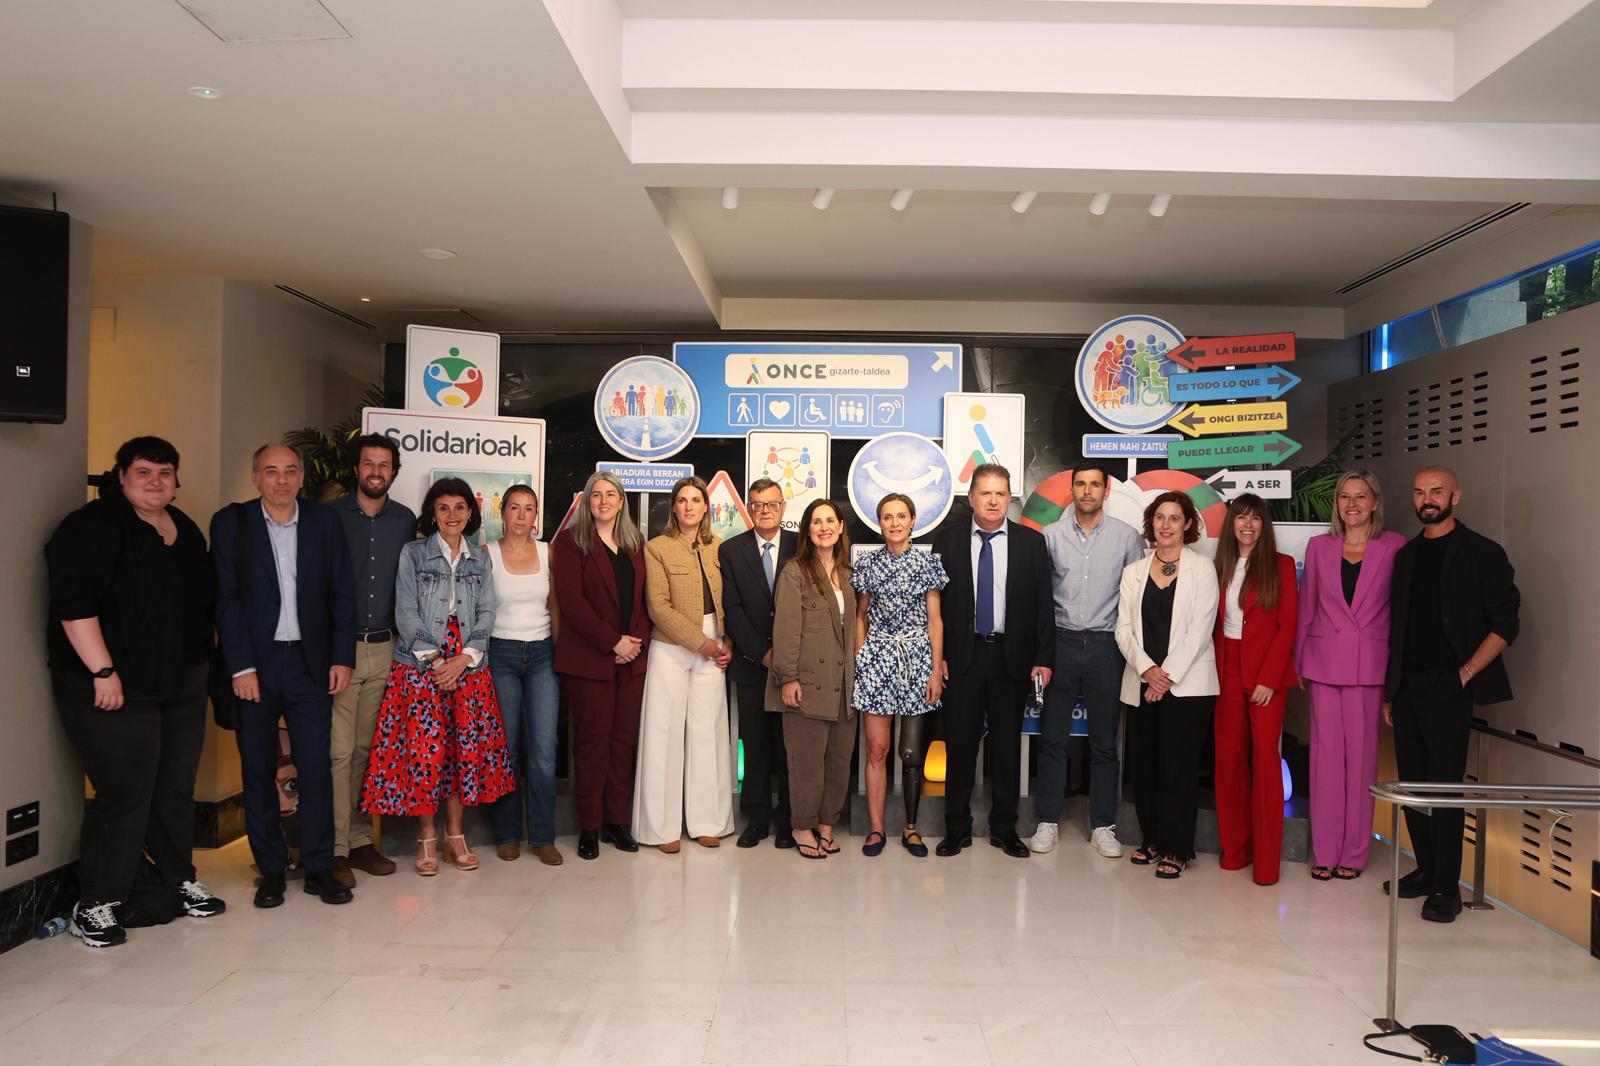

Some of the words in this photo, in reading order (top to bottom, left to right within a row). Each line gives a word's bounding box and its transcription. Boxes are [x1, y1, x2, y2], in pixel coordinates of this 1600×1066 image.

[1215, 347, 1230, 356] LA
[1232, 343, 1286, 354] REALIDAD
[766, 364, 827, 379] ONCE
[829, 366, 891, 377] gizarte-taldea
[1176, 383, 1188, 391] ES
[1191, 381, 1220, 390] TODO
[1222, 380, 1237, 388] LO
[1239, 379, 1261, 388] QUE
[1209, 415, 1235, 424] ONGI
[1237, 412, 1284, 422] BIZITZEA
[384, 427, 527, 458] Solidarioak
[1089, 442, 1118, 451] HEMEN
[1120, 442, 1140, 451] NAHI
[1178, 448, 1212, 458] PUEDE
[1214, 445, 1255, 455] LLEGAR
[609, 468, 651, 477] ABIADURA
[652, 469, 684, 478] BEREAN
[621, 478, 636, 486] ERA
[636, 478, 654, 486] EGIN
[1245, 480, 1254, 489] A
[1257, 480, 1281, 489] SER
[780, 520, 801, 529] SON
